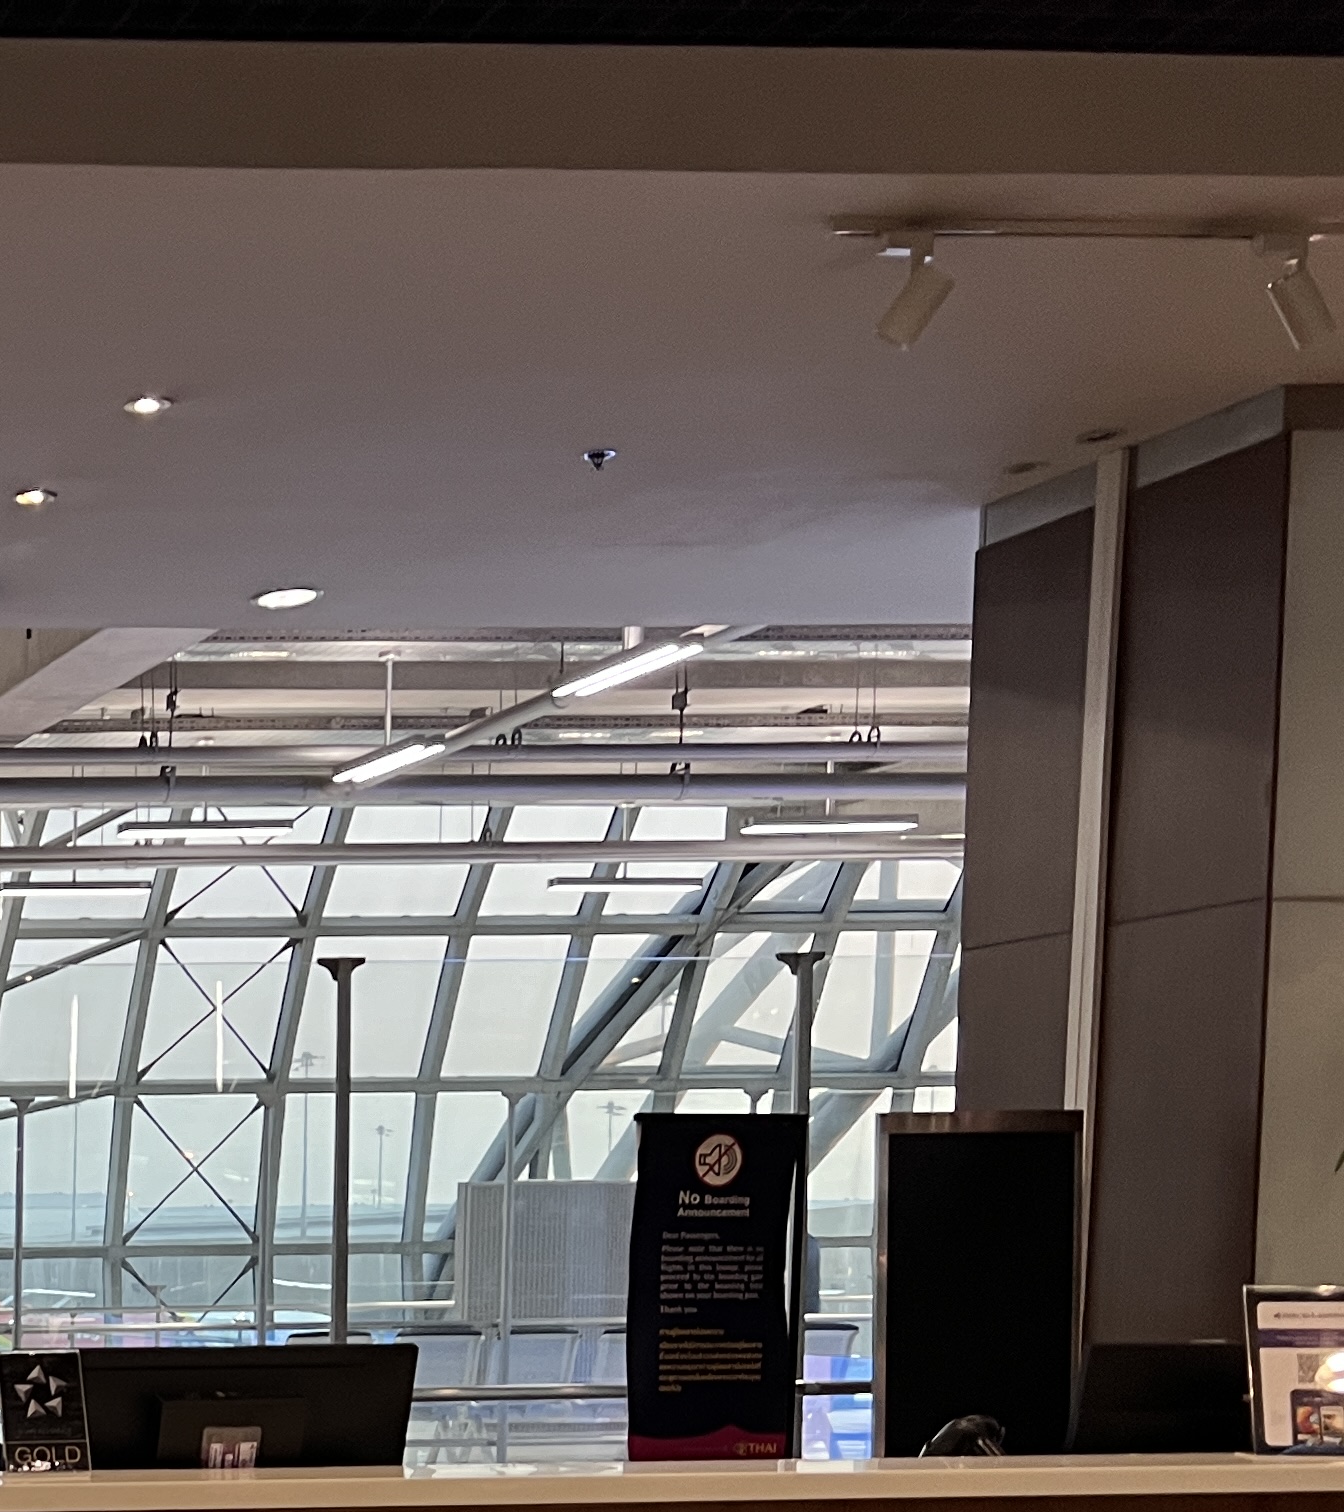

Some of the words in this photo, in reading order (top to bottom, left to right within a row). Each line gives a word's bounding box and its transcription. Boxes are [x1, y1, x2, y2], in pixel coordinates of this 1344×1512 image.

[678, 1190, 700, 1205] No
[704, 1194, 751, 1207] Boarding
[677, 1207, 750, 1217] Announcement
[15, 1446, 81, 1465] GOLD
[748, 1443, 777, 1454] THAI
